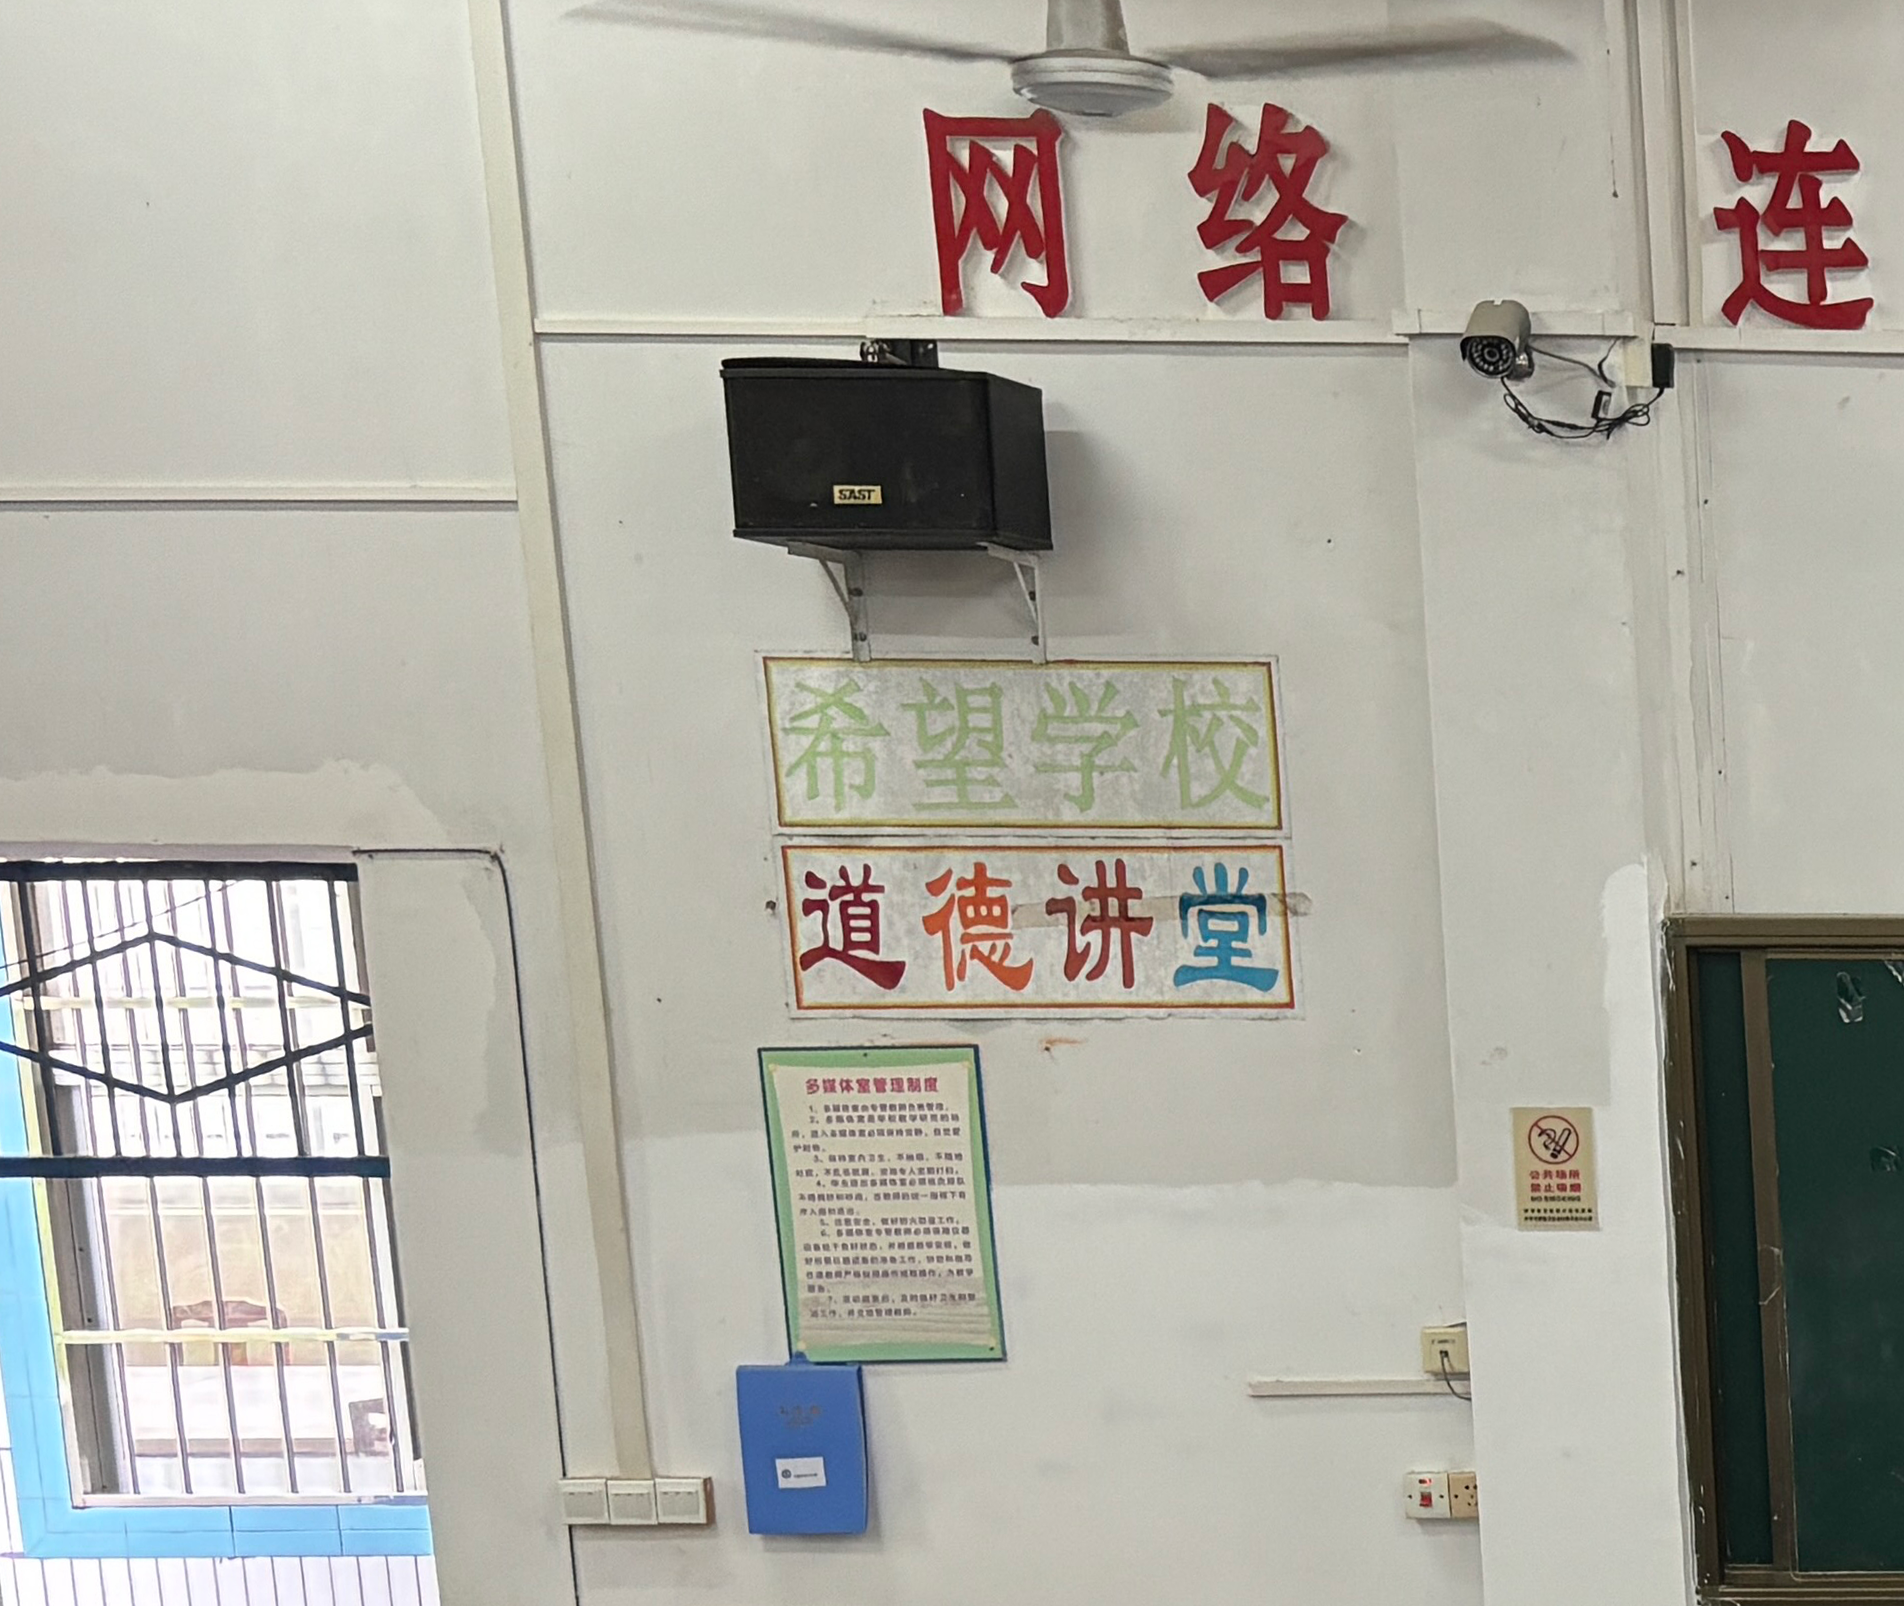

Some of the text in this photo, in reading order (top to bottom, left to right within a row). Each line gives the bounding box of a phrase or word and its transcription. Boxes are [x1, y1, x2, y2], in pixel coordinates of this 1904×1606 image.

[924, 102, 1348, 321] 网络
[838, 488, 876, 501] SAST
[781, 675, 1271, 813] 希望学校
[799, 858, 1281, 993] 道德讲堂
[805, 1076, 940, 1096] 多媒体室管理制度
